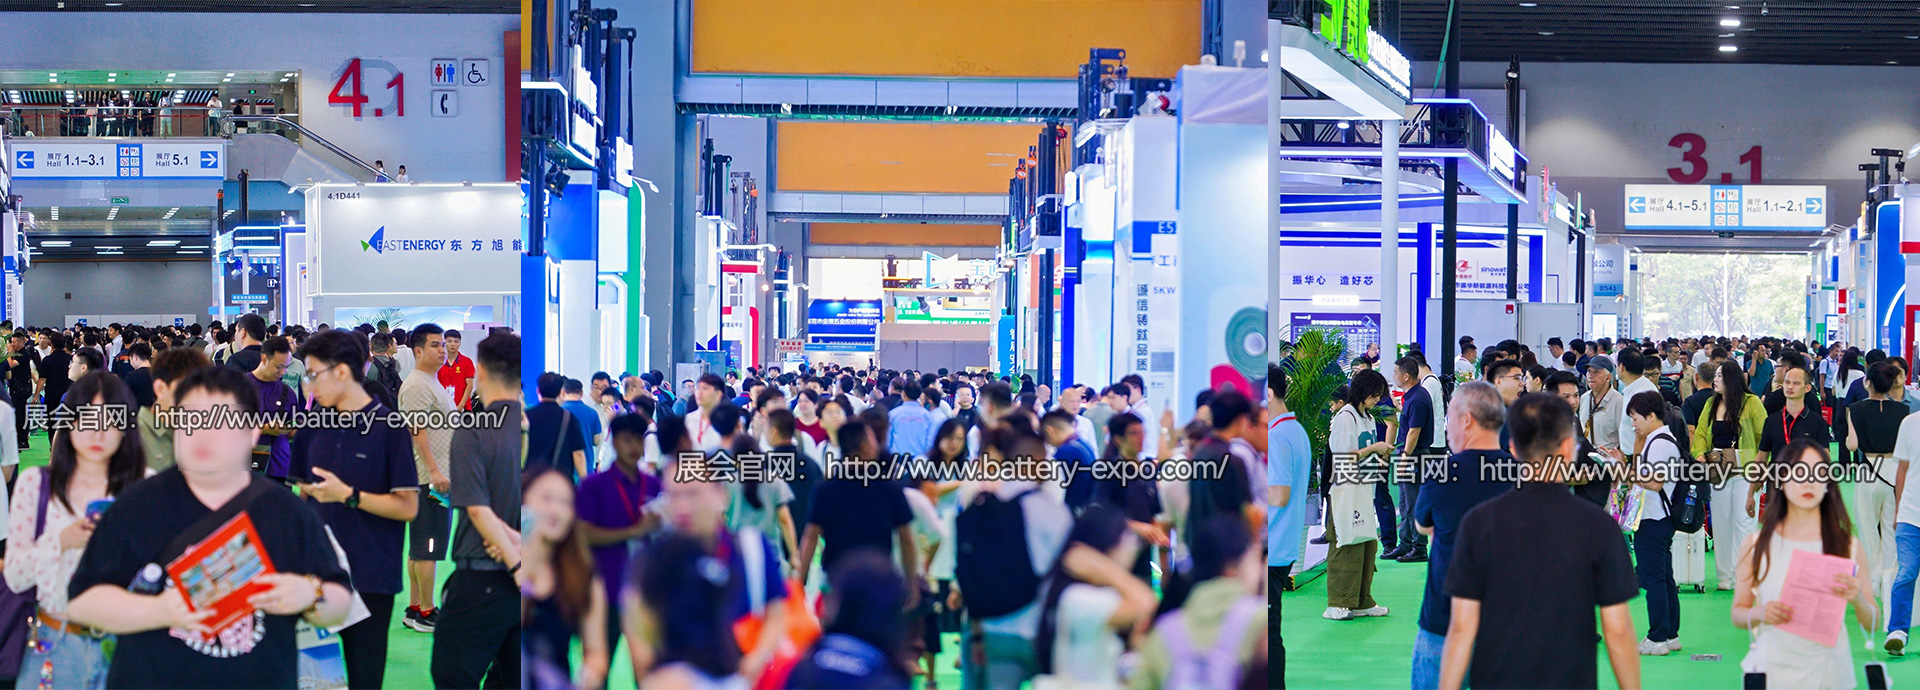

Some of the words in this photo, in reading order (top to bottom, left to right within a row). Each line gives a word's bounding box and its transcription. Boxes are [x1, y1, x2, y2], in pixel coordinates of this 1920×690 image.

[328, 58, 404, 117] 4.1
[47, 152, 61, 160] 展厅
[155, 152, 170, 160] 展厅
[172, 153, 189, 166] 5.1
[1667, 133, 1762, 184] 3.1
[327, 192, 360, 200] 4.1D441
[1649, 205, 1664, 213] Hall
[1746, 205, 1761, 213] Hall
[1157, 221, 1176, 234] E5
[1292, 275, 1326, 285] 振华心
[1340, 275, 1374, 286] 造好芯
